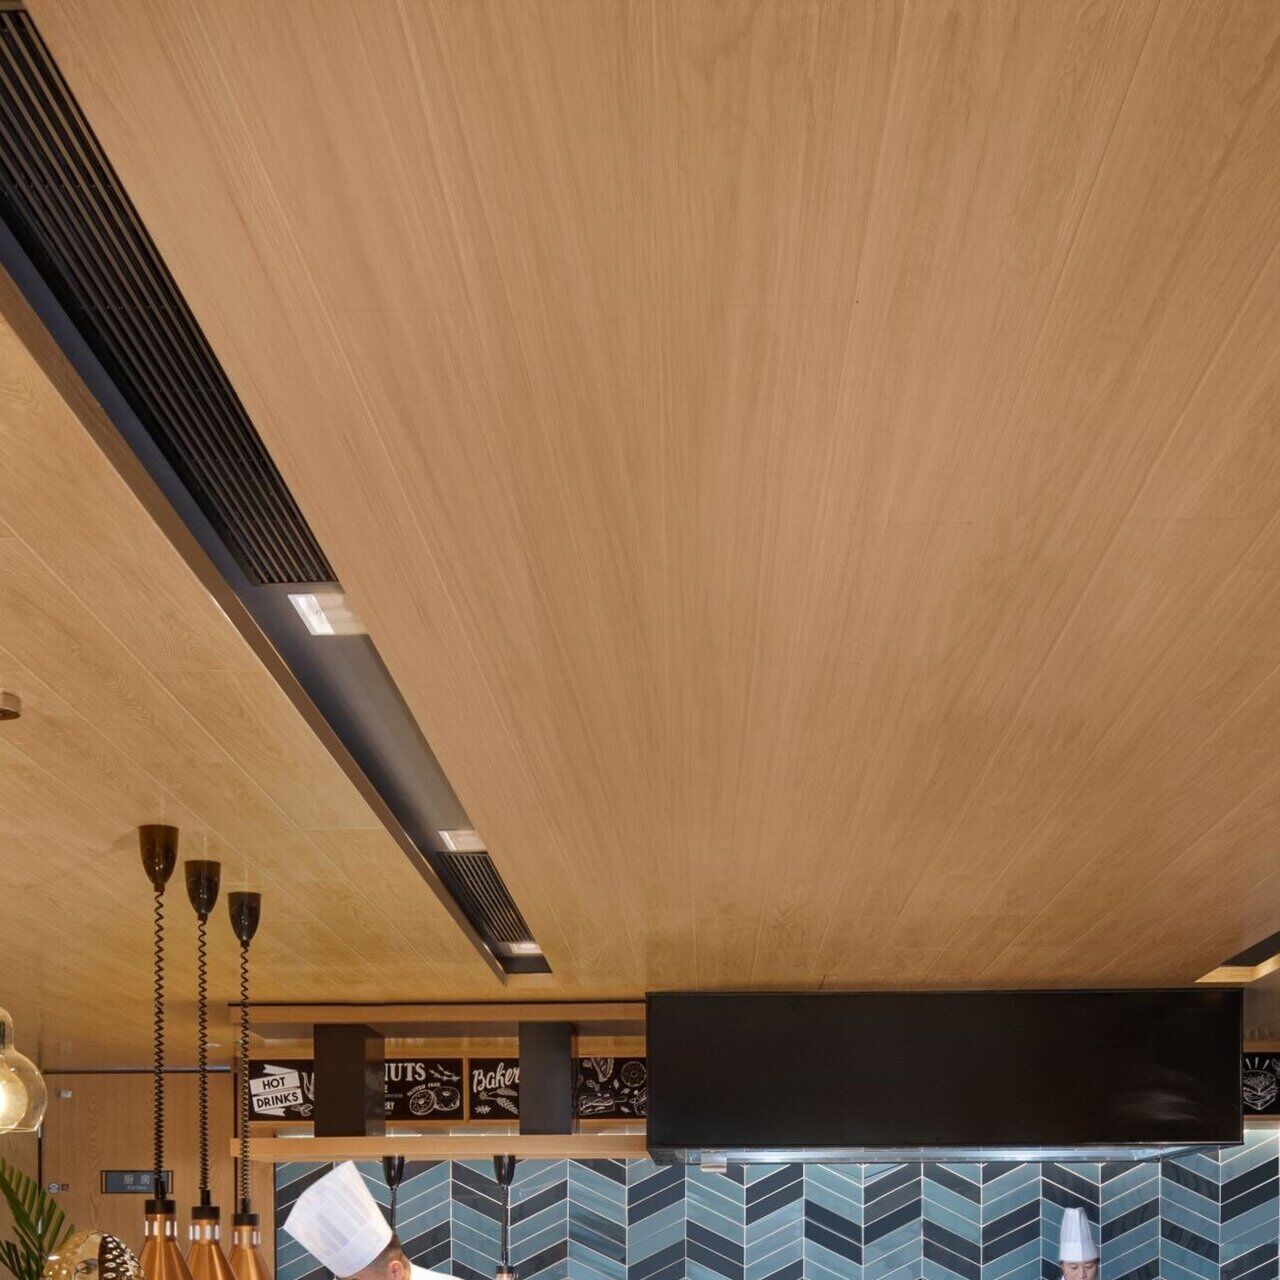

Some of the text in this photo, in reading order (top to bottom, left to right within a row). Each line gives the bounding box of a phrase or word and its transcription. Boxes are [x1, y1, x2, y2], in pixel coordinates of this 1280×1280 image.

[262, 1076, 286, 1091] HOT
[472, 1061, 520, 1094] Baker
[256, 1091, 300, 1109] DRINKS
